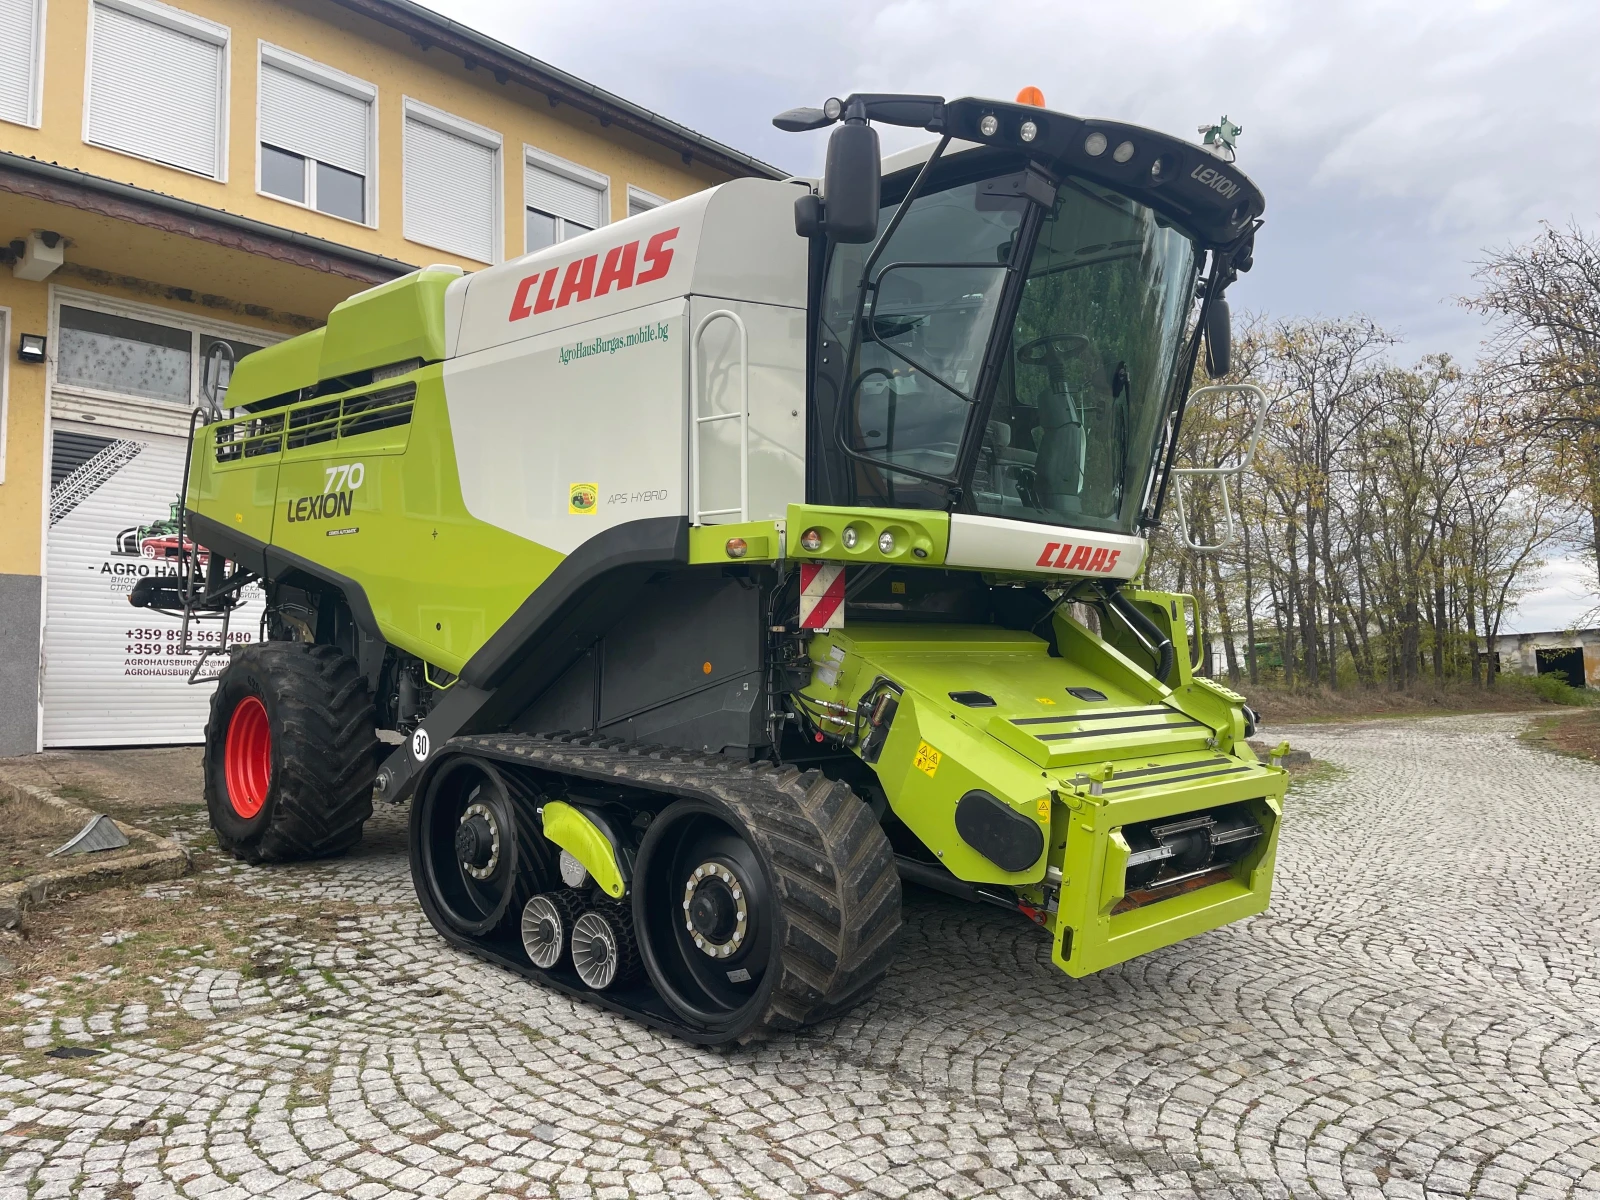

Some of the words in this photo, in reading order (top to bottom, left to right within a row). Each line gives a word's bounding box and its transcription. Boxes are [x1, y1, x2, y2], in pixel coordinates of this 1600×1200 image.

[1190, 164, 1241, 199] LEXION
[508, 226, 681, 323] CLAAS
[558, 322, 669, 365] AgroHausBurgas.mobile.bg
[323, 462, 365, 494] 770
[287, 490, 354, 523] LEXION
[607, 492, 628, 505] APS
[630, 489, 668, 503] HYBRID
[100, 561, 150, 577] AGRO
[1036, 542, 1121, 573] CLAAS
[125, 628, 162, 641] +359
[166, 629, 193, 641] 898
[226, 632, 252, 643] 480
[125, 643, 162, 655] +359
[415, 734, 427, 756] 30
